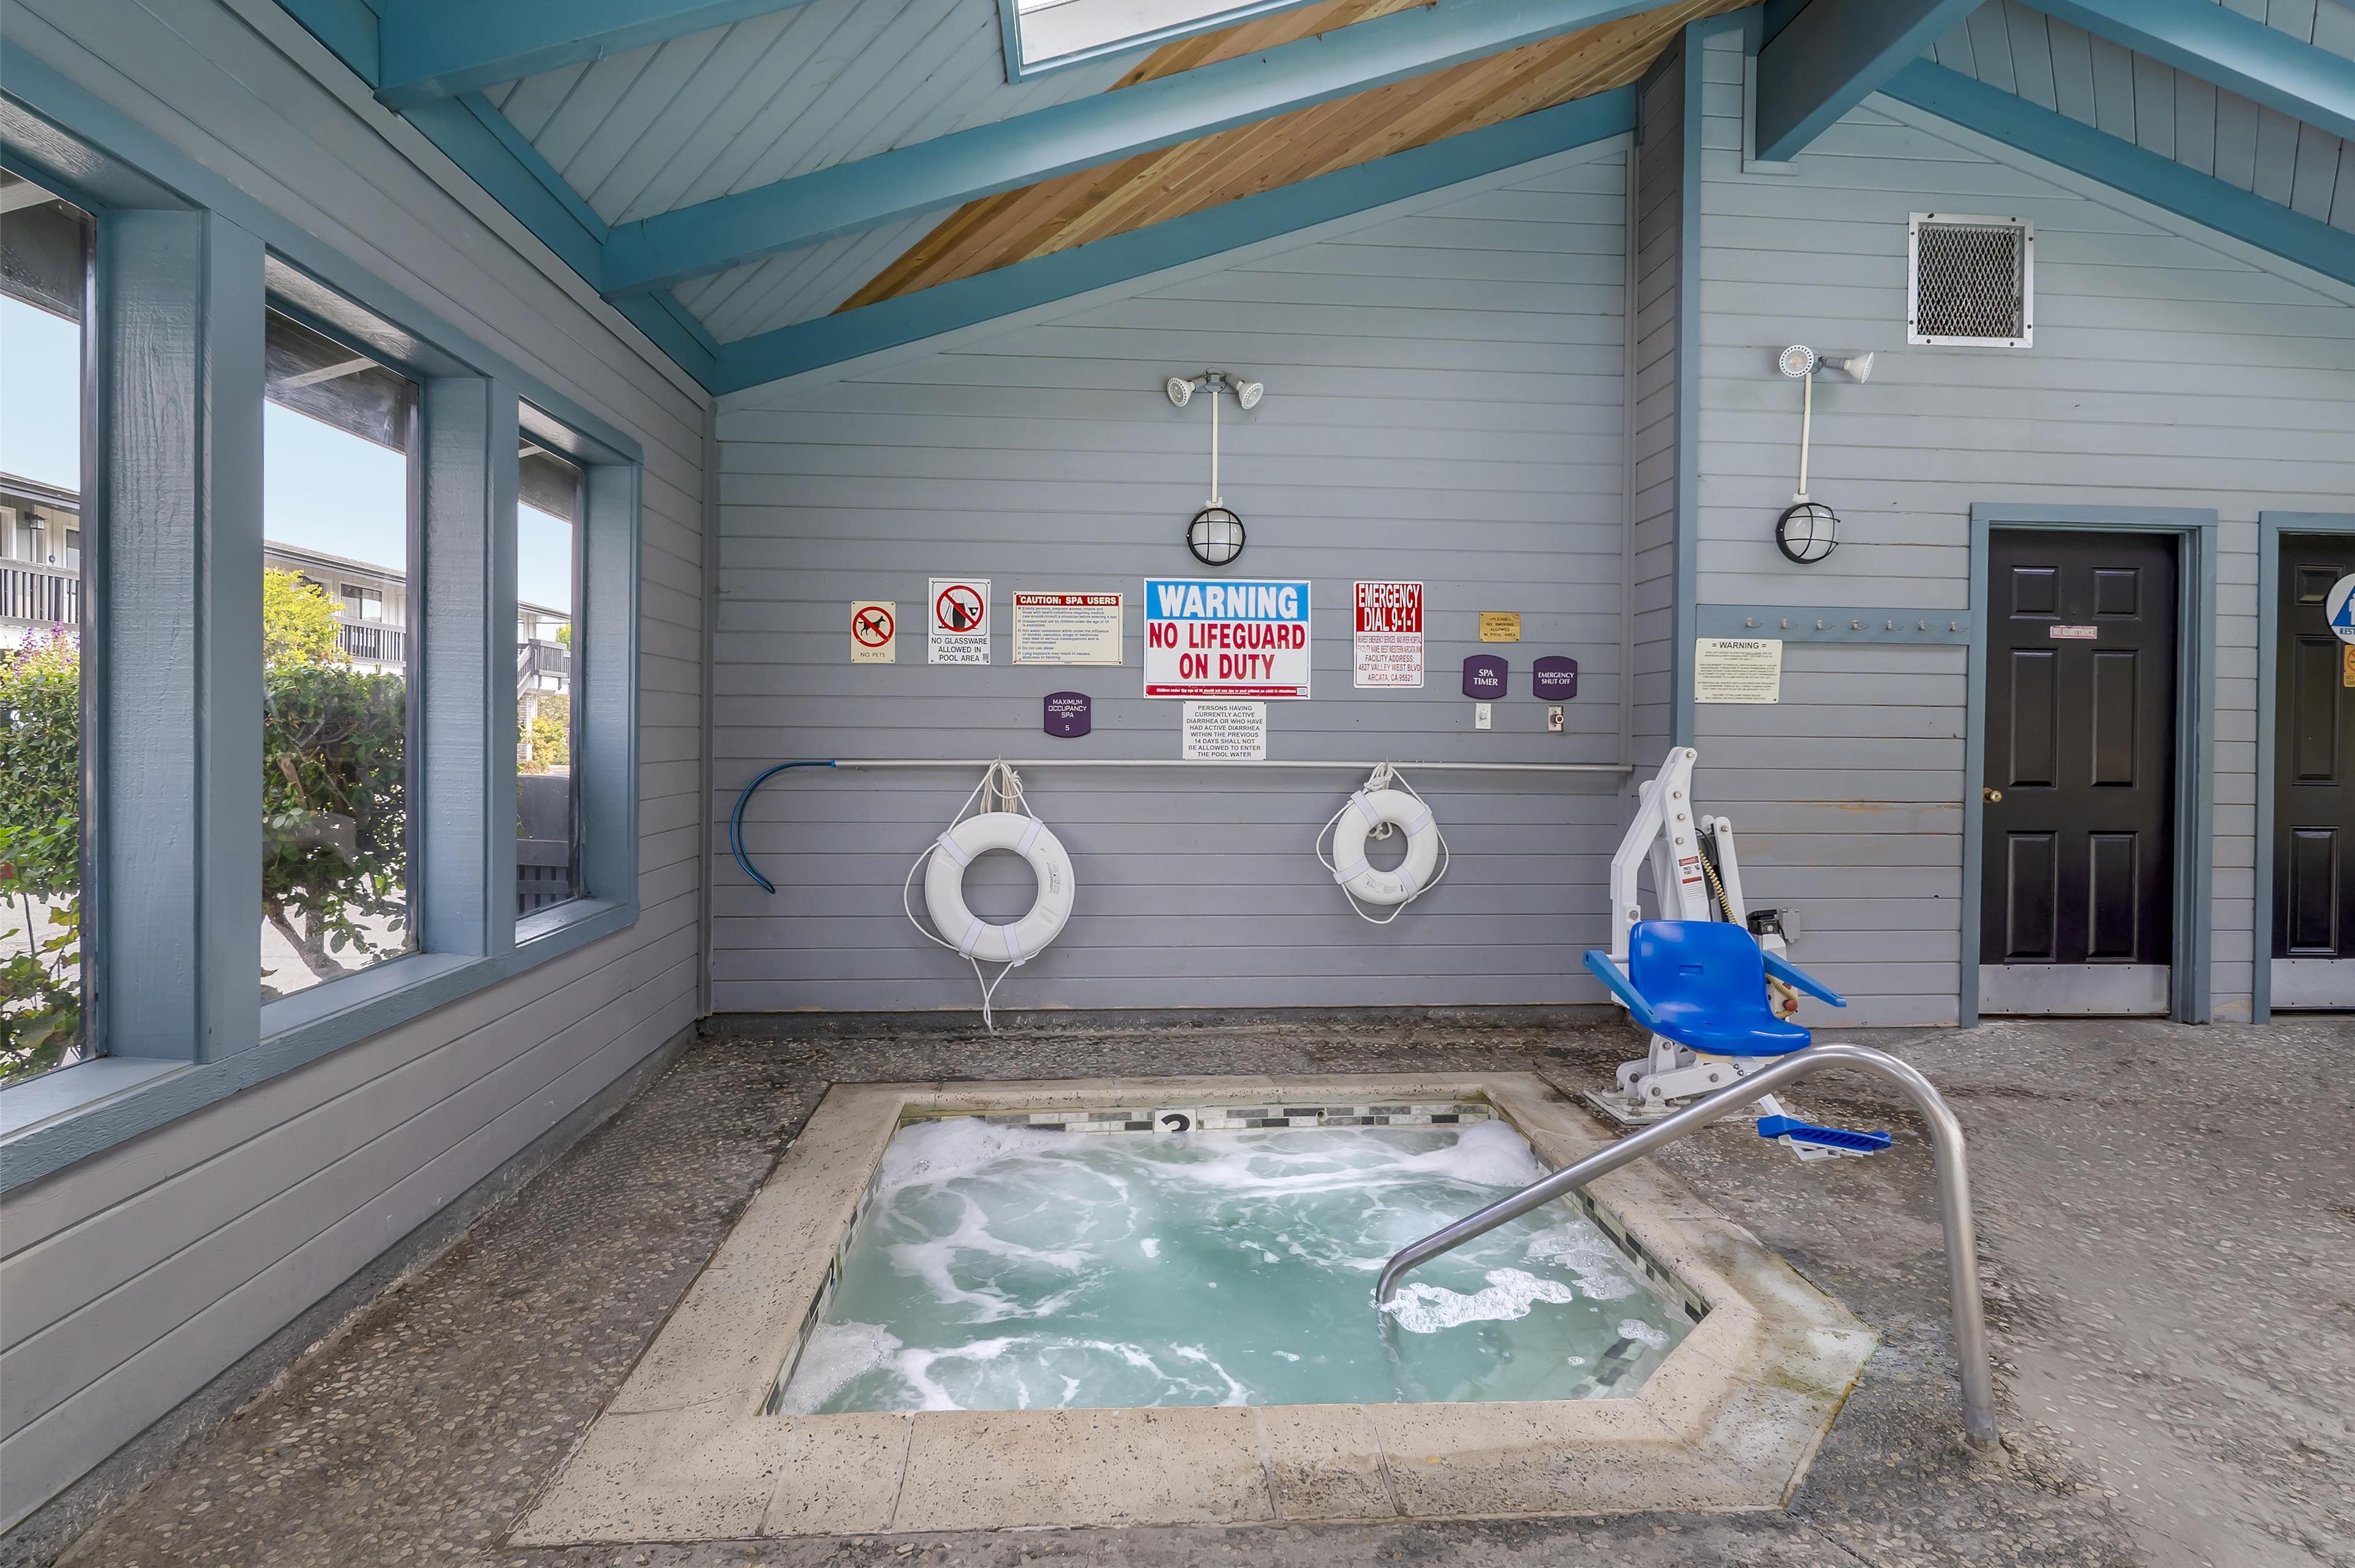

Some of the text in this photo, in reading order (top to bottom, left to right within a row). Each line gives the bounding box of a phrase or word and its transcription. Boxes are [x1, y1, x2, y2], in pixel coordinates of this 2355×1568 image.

[1158, 585, 1298, 619] WARNING
[1358, 584, 1420, 608] EMERGENCY
[1365, 608, 1415, 632] DIAL 9-1-1
[1149, 622, 1306, 650] NO LIFEGUARD
[1179, 652, 1276, 680] ON DUTY
[1473, 677, 1498, 686] TIMER
